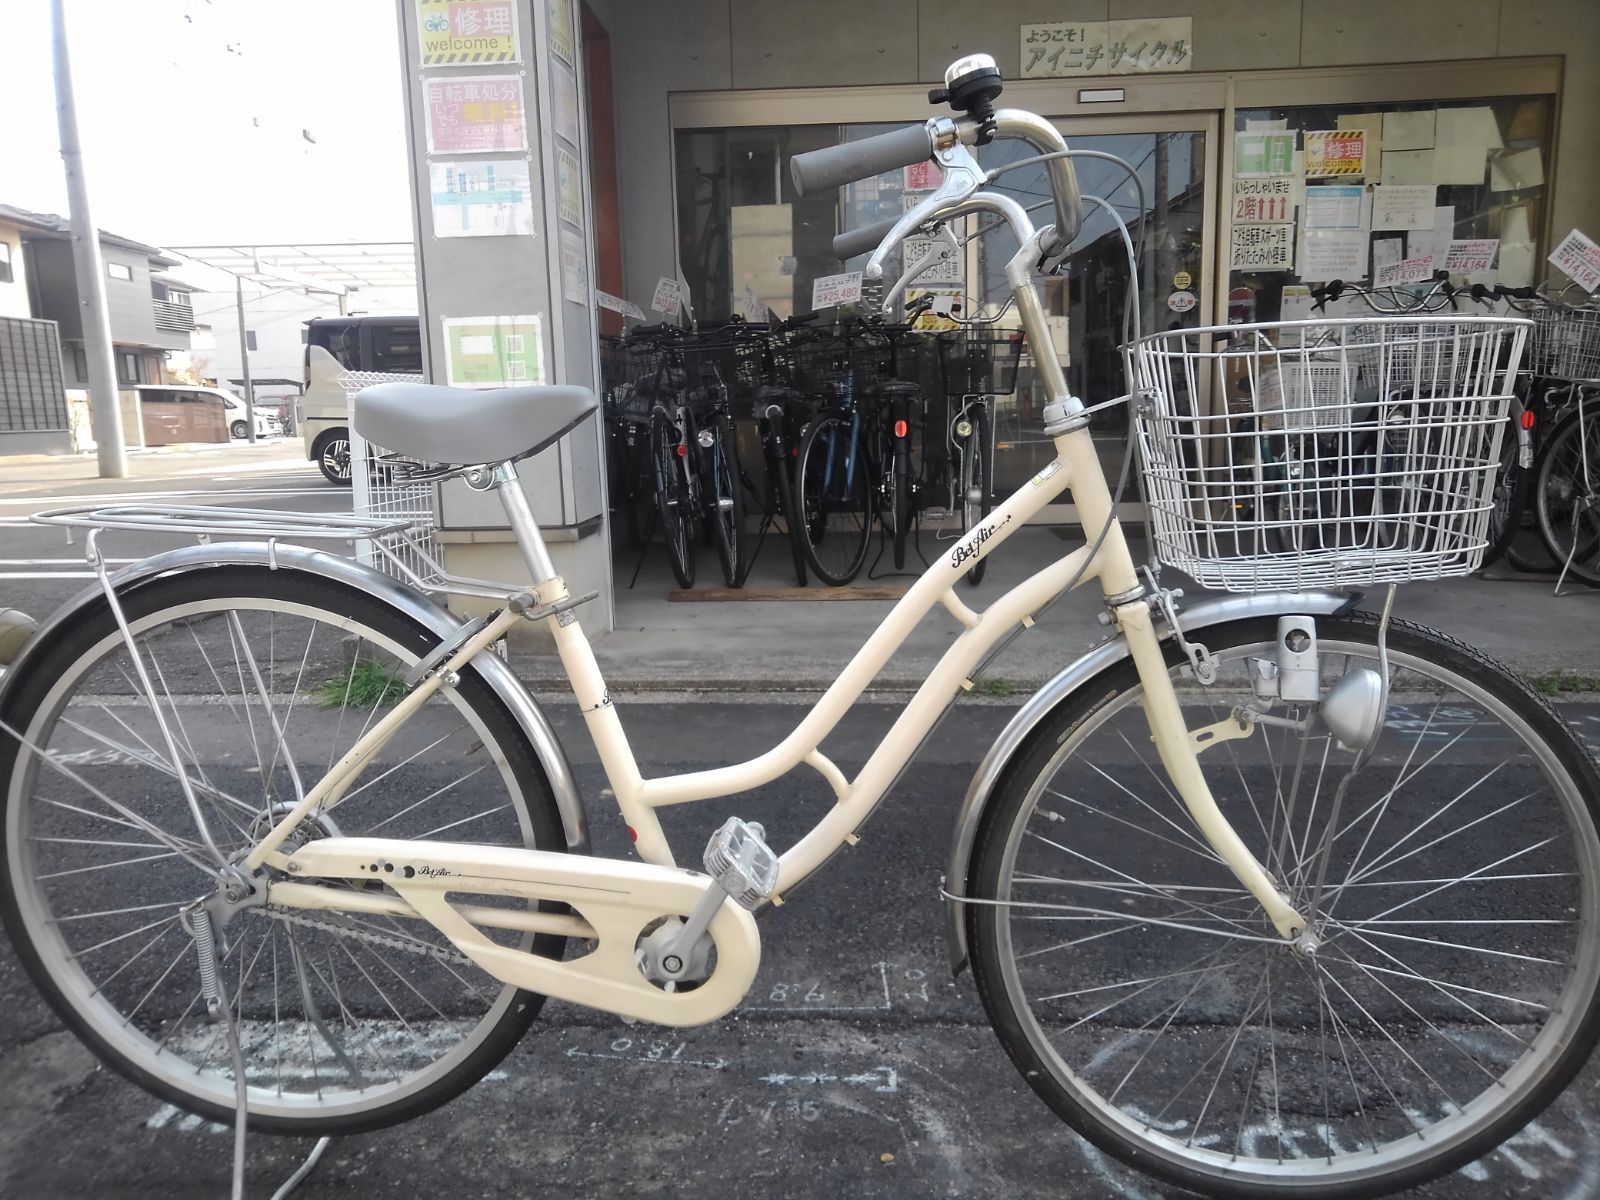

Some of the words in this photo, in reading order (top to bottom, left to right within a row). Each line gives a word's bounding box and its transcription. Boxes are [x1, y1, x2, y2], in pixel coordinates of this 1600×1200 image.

[455, 7, 511, 34] 修理
[426, 35, 498, 52] welcome
[1026, 39, 1187, 72] アイニチサイクル
[429, 82, 518, 104] 自転車処分
[1327, 141, 1362, 159] 修理
[1307, 159, 1353, 168] welcome
[1235, 180, 1290, 194] いらっしゃいませ
